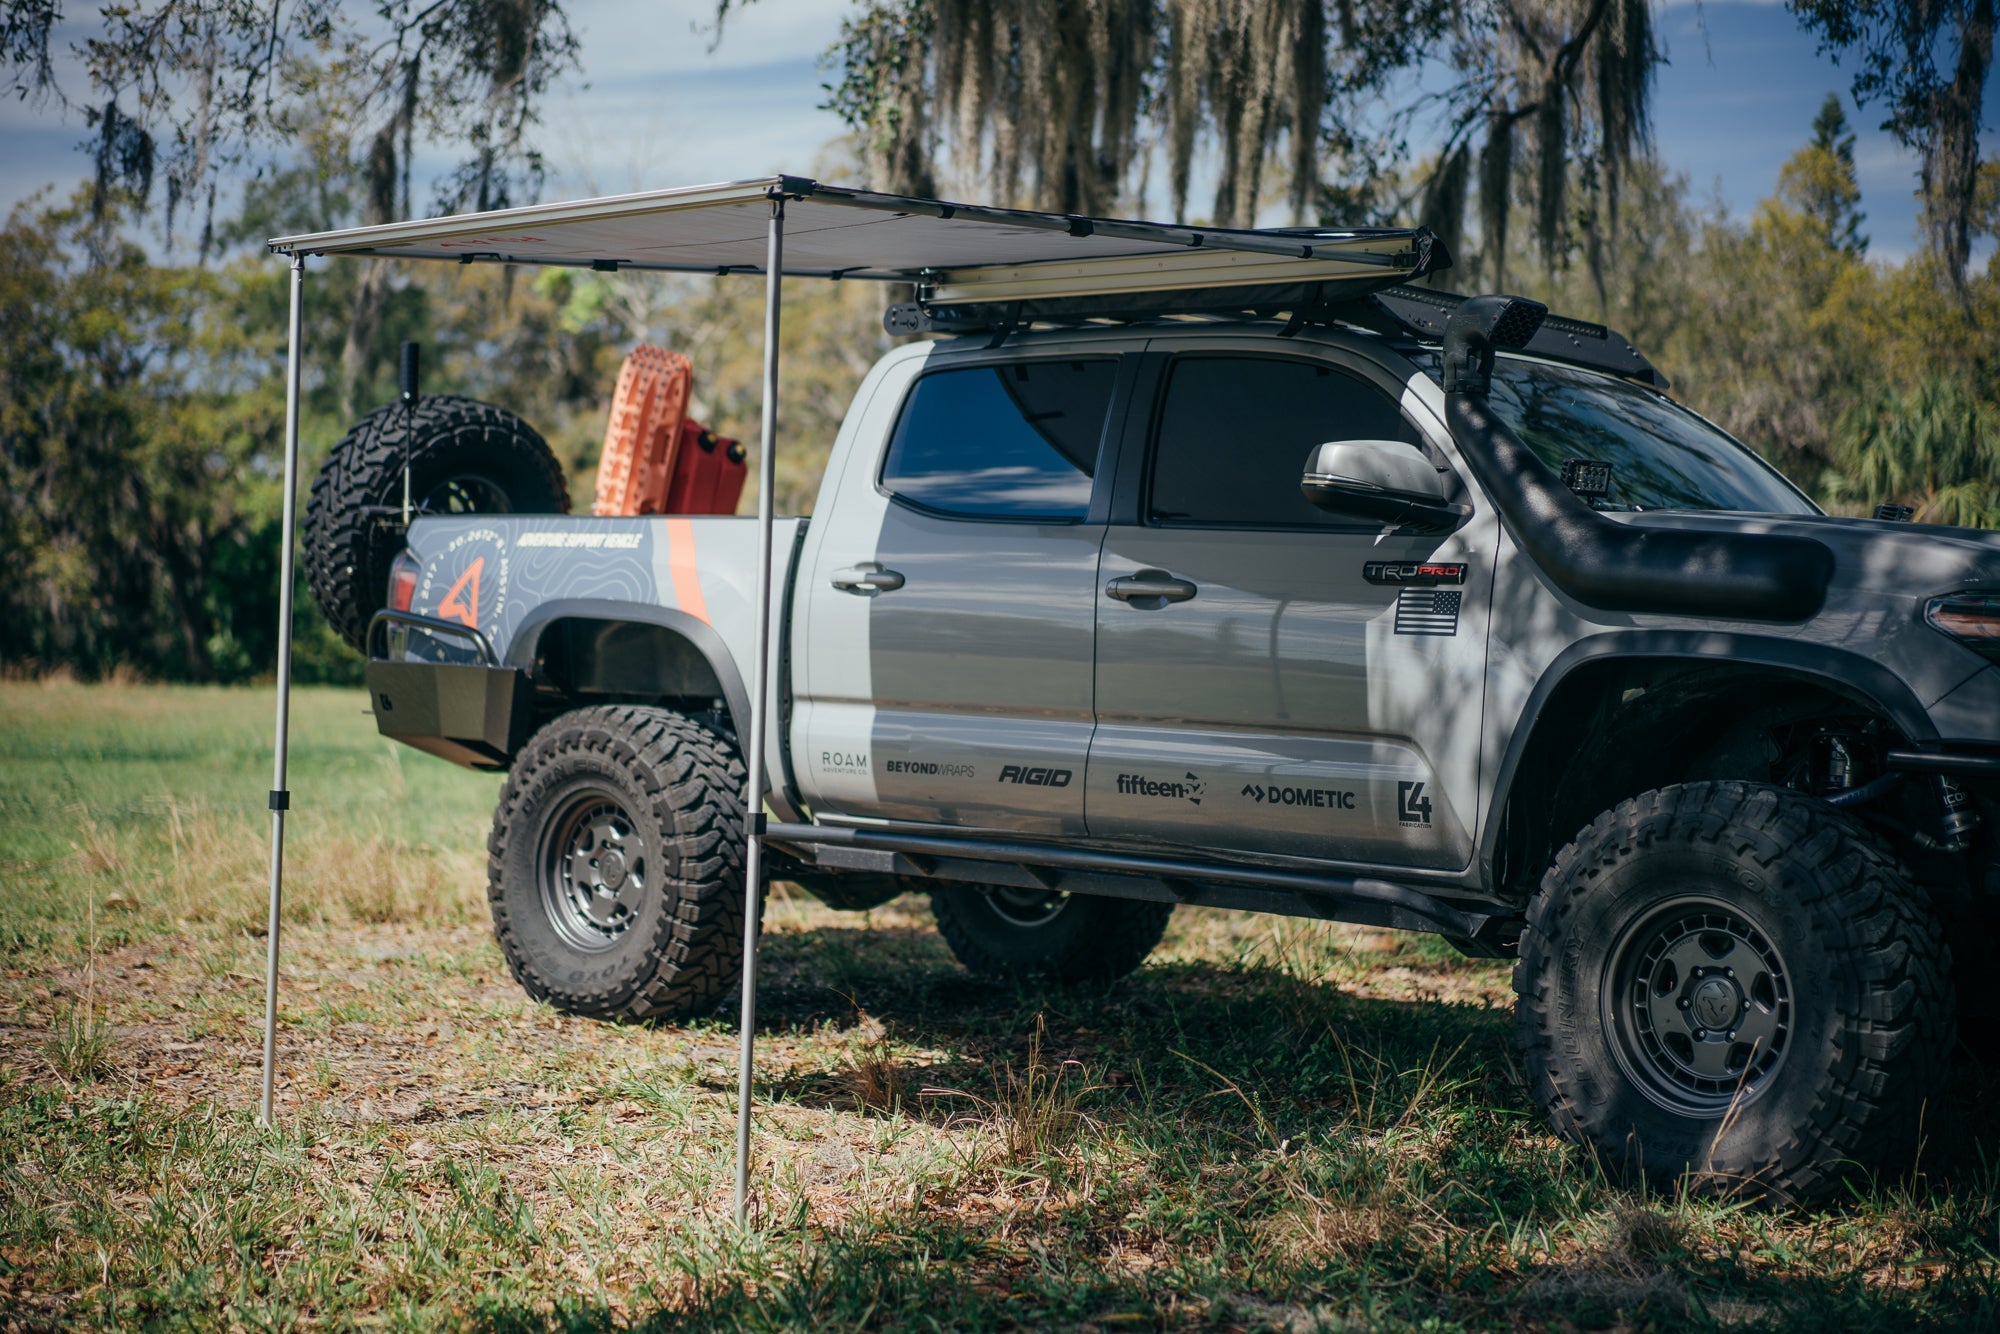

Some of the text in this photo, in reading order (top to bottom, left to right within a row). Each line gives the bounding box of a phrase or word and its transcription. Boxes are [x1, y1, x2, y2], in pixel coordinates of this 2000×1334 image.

[602, 533, 644, 549] VEHICLE
[1417, 566, 1459, 576] PRO
[822, 751, 867, 768] ROAM
[886, 760, 975, 778] BEYONDWRAPS
[998, 765, 1072, 787] RIGID
[1268, 786, 1356, 810] DOMETIC
